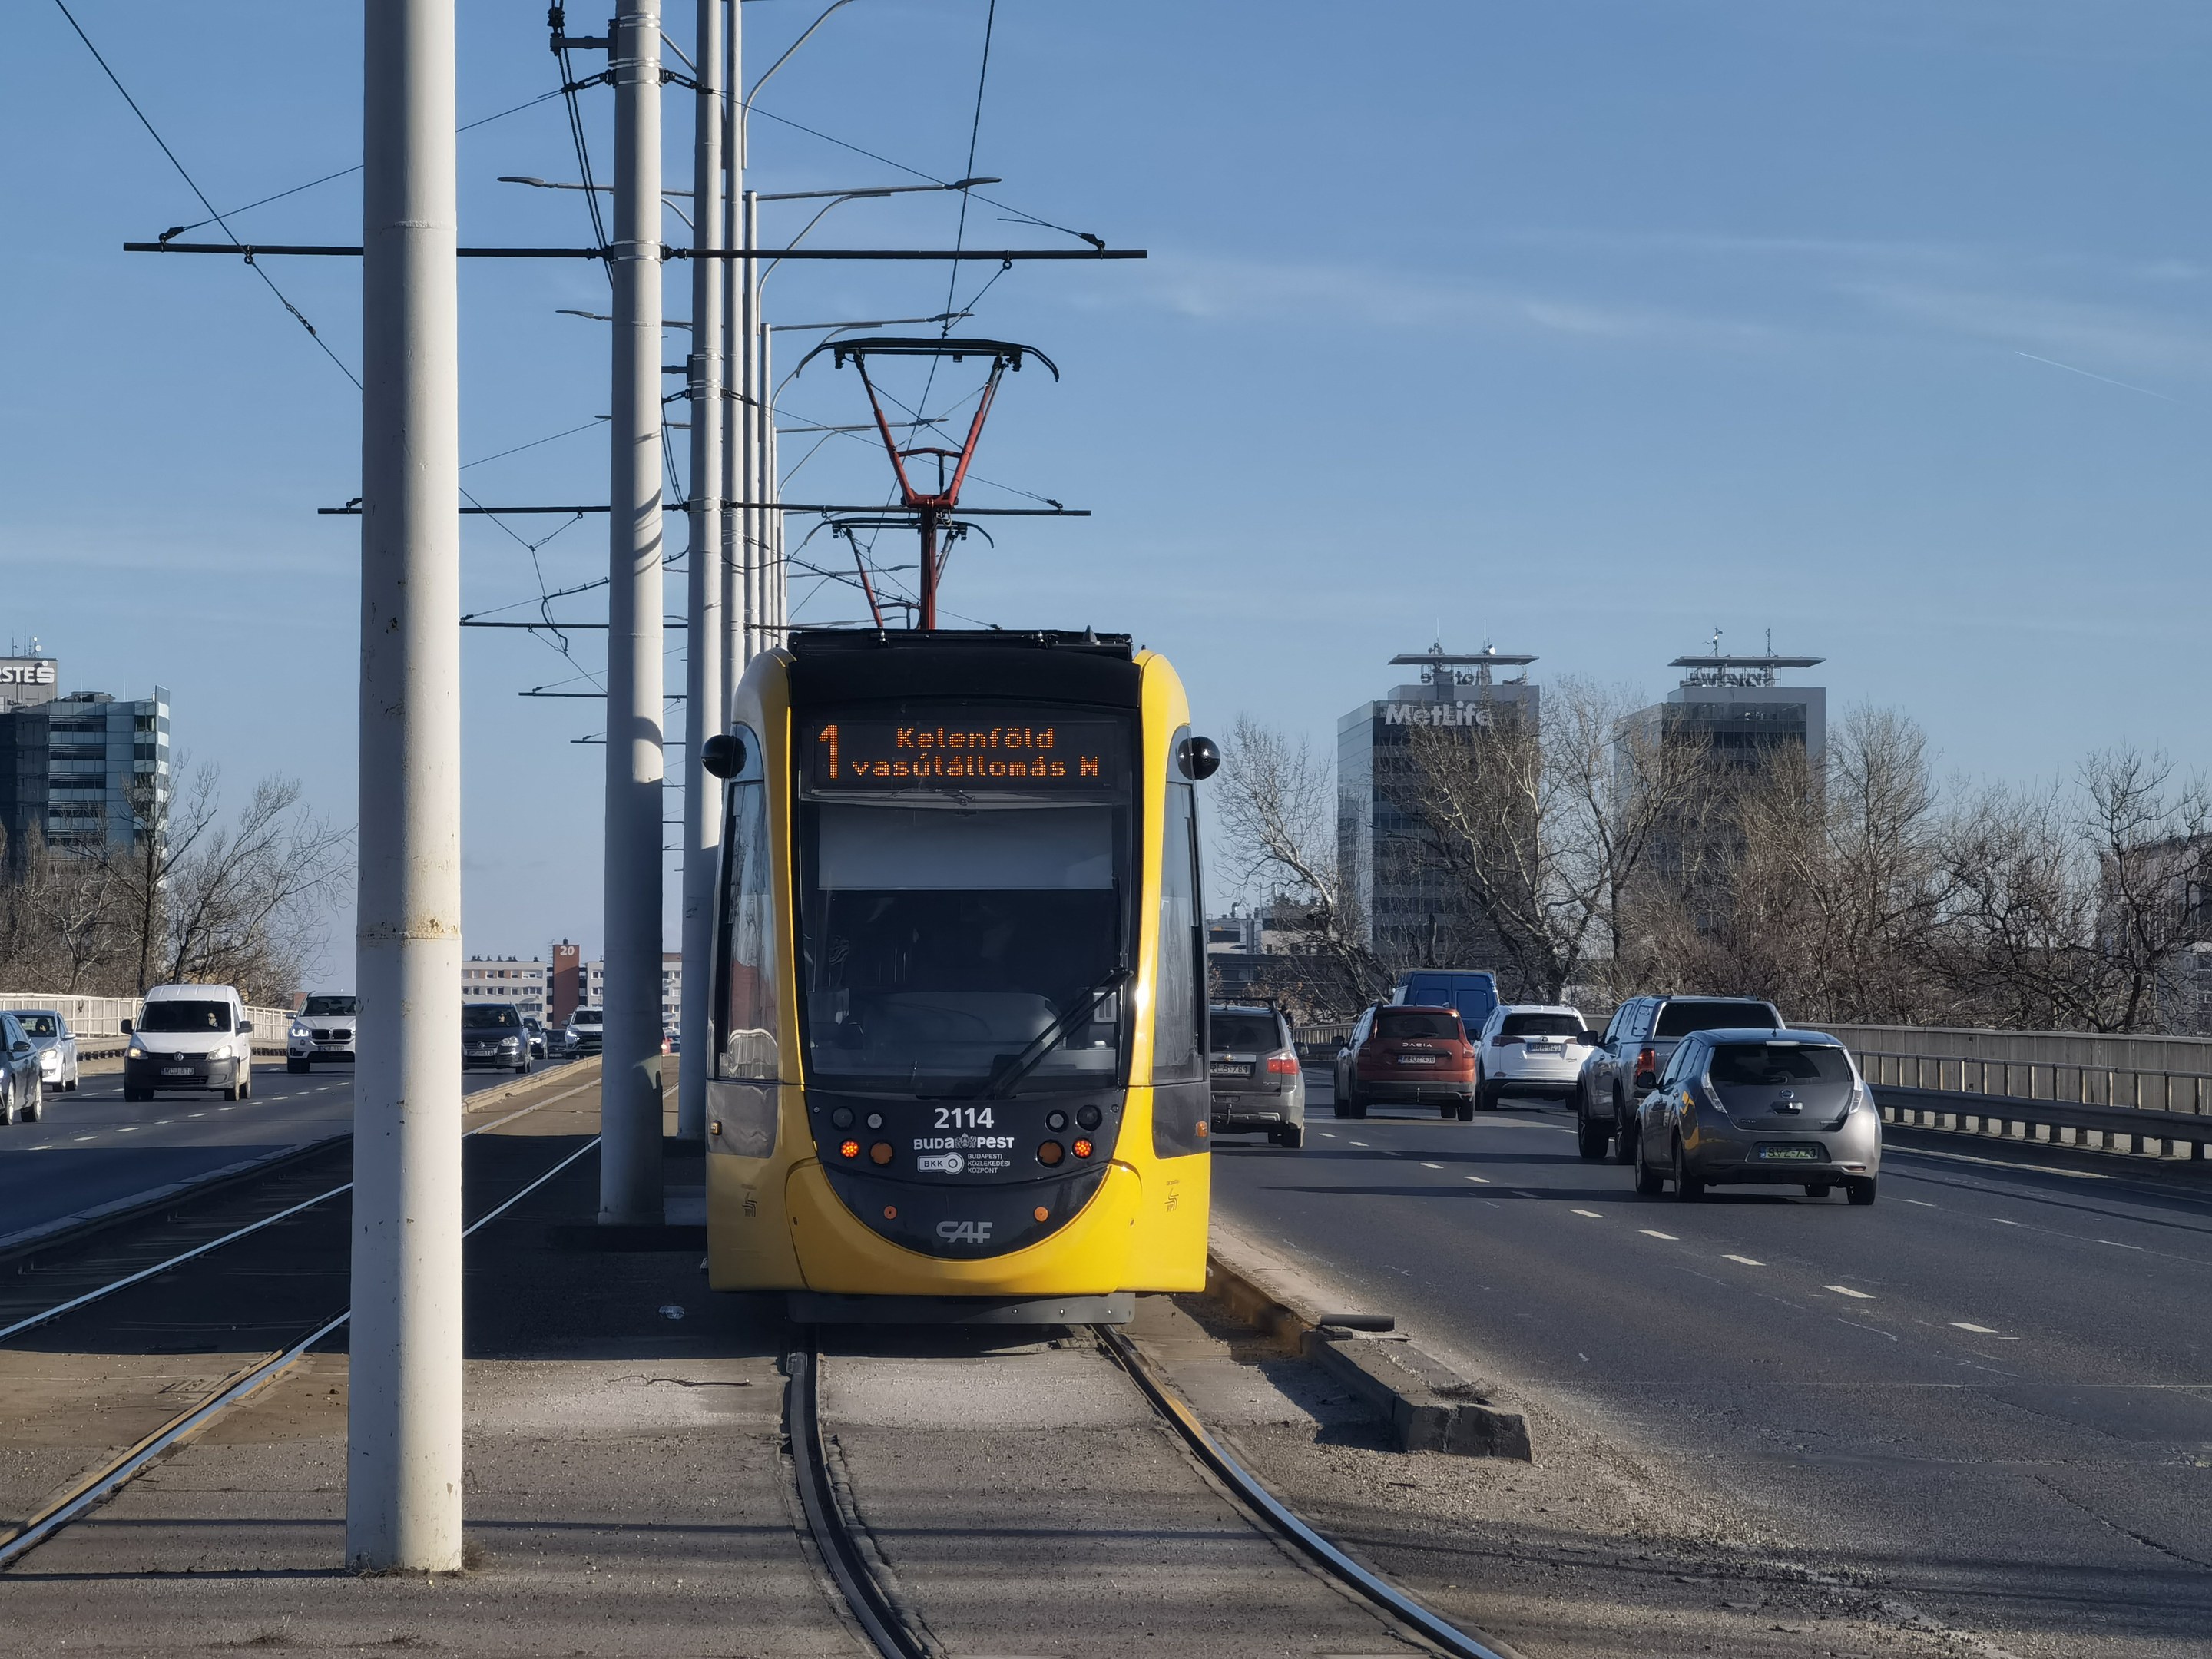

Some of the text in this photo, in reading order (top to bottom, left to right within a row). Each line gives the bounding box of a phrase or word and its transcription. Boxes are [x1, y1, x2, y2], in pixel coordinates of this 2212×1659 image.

[1385, 700, 1490, 726] MetLife
[896, 727, 1054, 748] Kelenföld
[819, 724, 839, 779] 1
[852, 753, 1098, 777] vasútállomás M
[560, 945, 575, 956] 20
[934, 1108, 994, 1128] 2114
[935, 1221, 993, 1243] CAF
